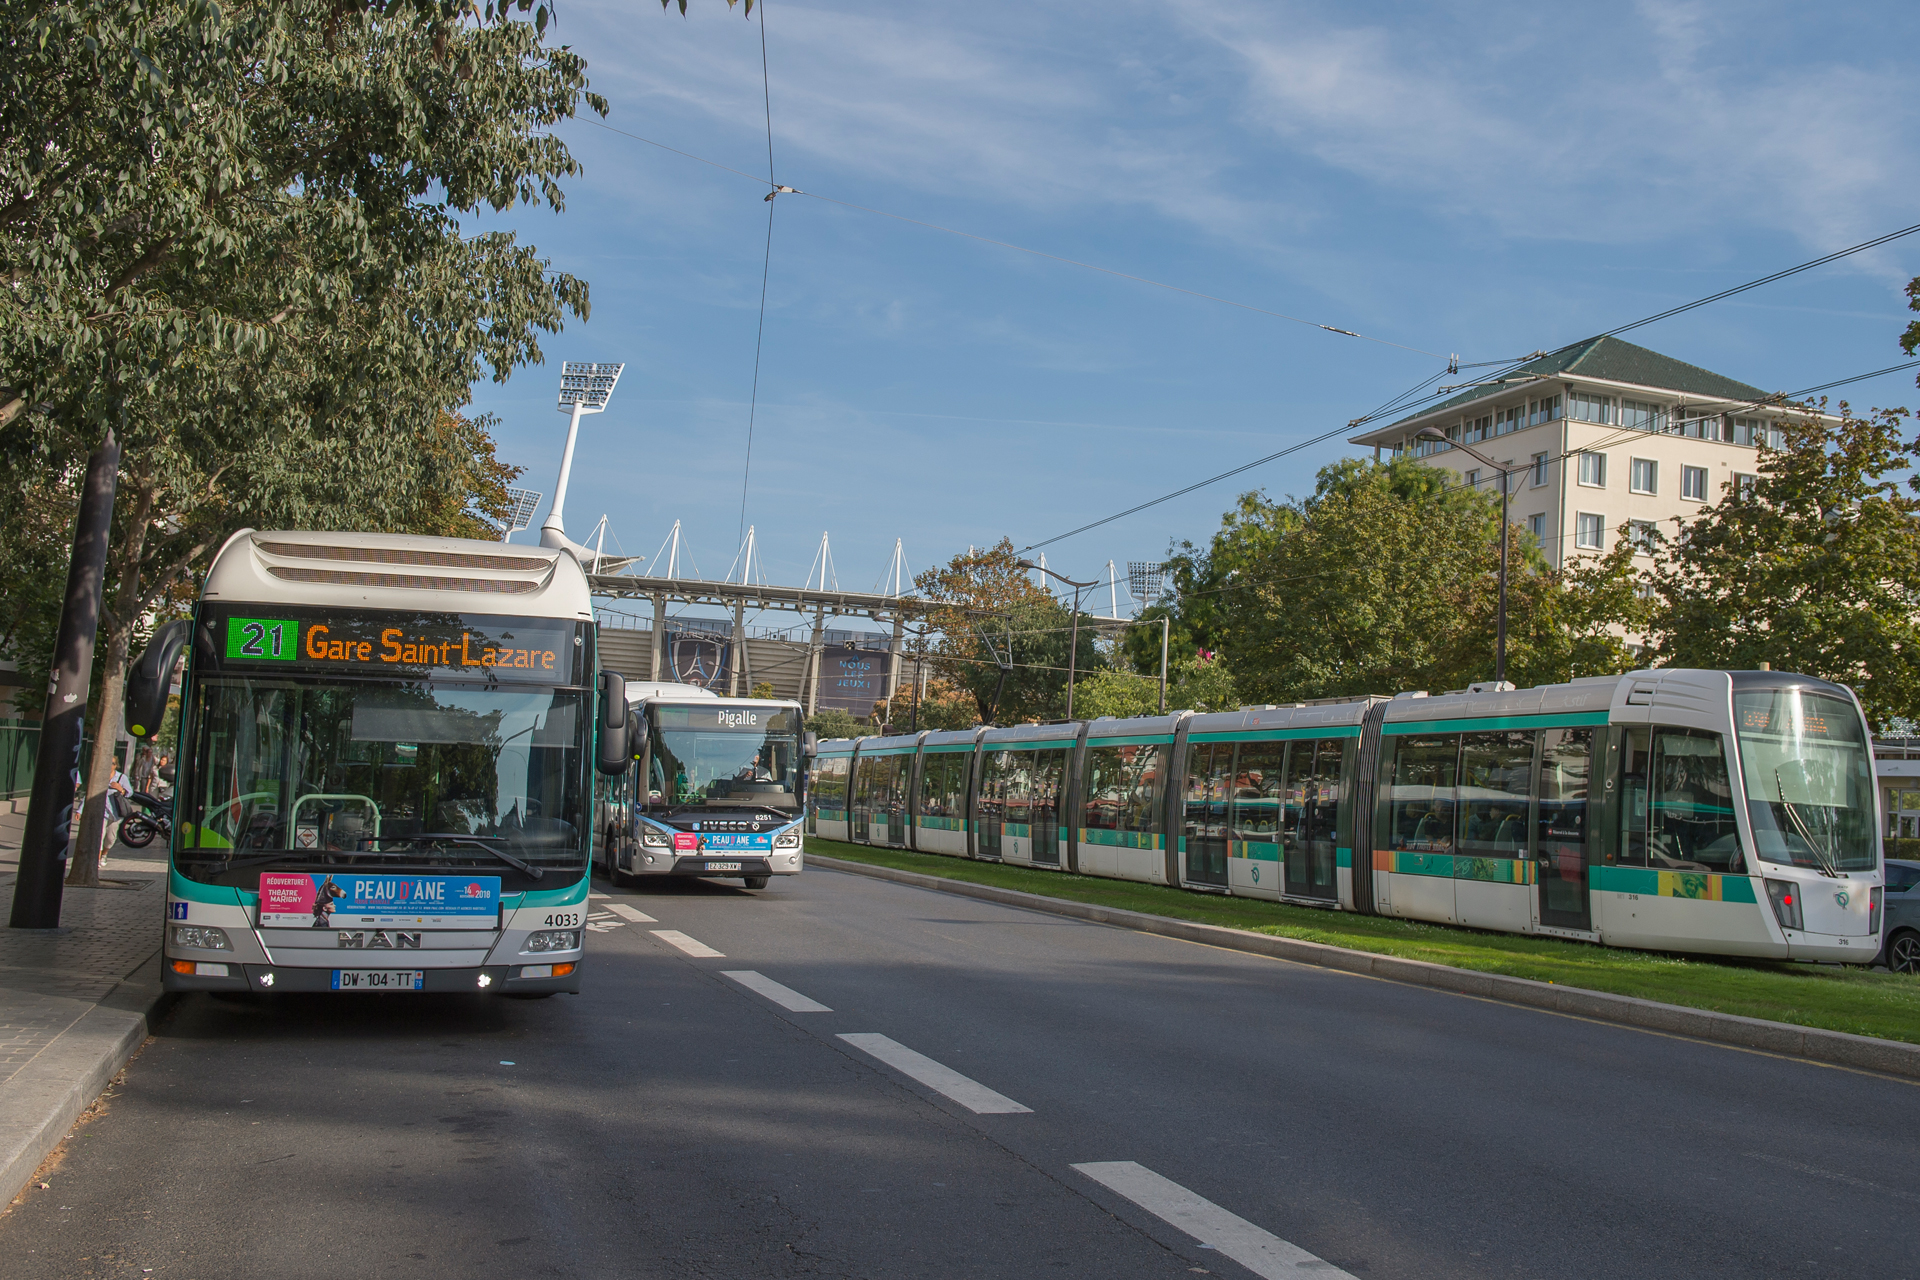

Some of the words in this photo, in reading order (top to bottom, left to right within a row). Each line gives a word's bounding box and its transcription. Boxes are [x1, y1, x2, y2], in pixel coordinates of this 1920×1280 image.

[676, 632, 704, 640] PARIS
[240, 622, 282, 656] 21
[306, 624, 372, 661] Gare
[380, 628, 556, 669] Saint-Lazare
[840, 660, 870, 670] NOUS
[844, 670, 864, 678] LES
[718, 710, 756, 728] Pigalle
[703, 820, 747, 830] IVECO
[712, 836, 730, 844] PEAU
[354, 880, 396, 900] PEAU
[464, 886, 472, 894] 14
[475, 890, 490, 899] 2018
[544, 913, 579, 926] 4033
[338, 931, 422, 948] MAN
